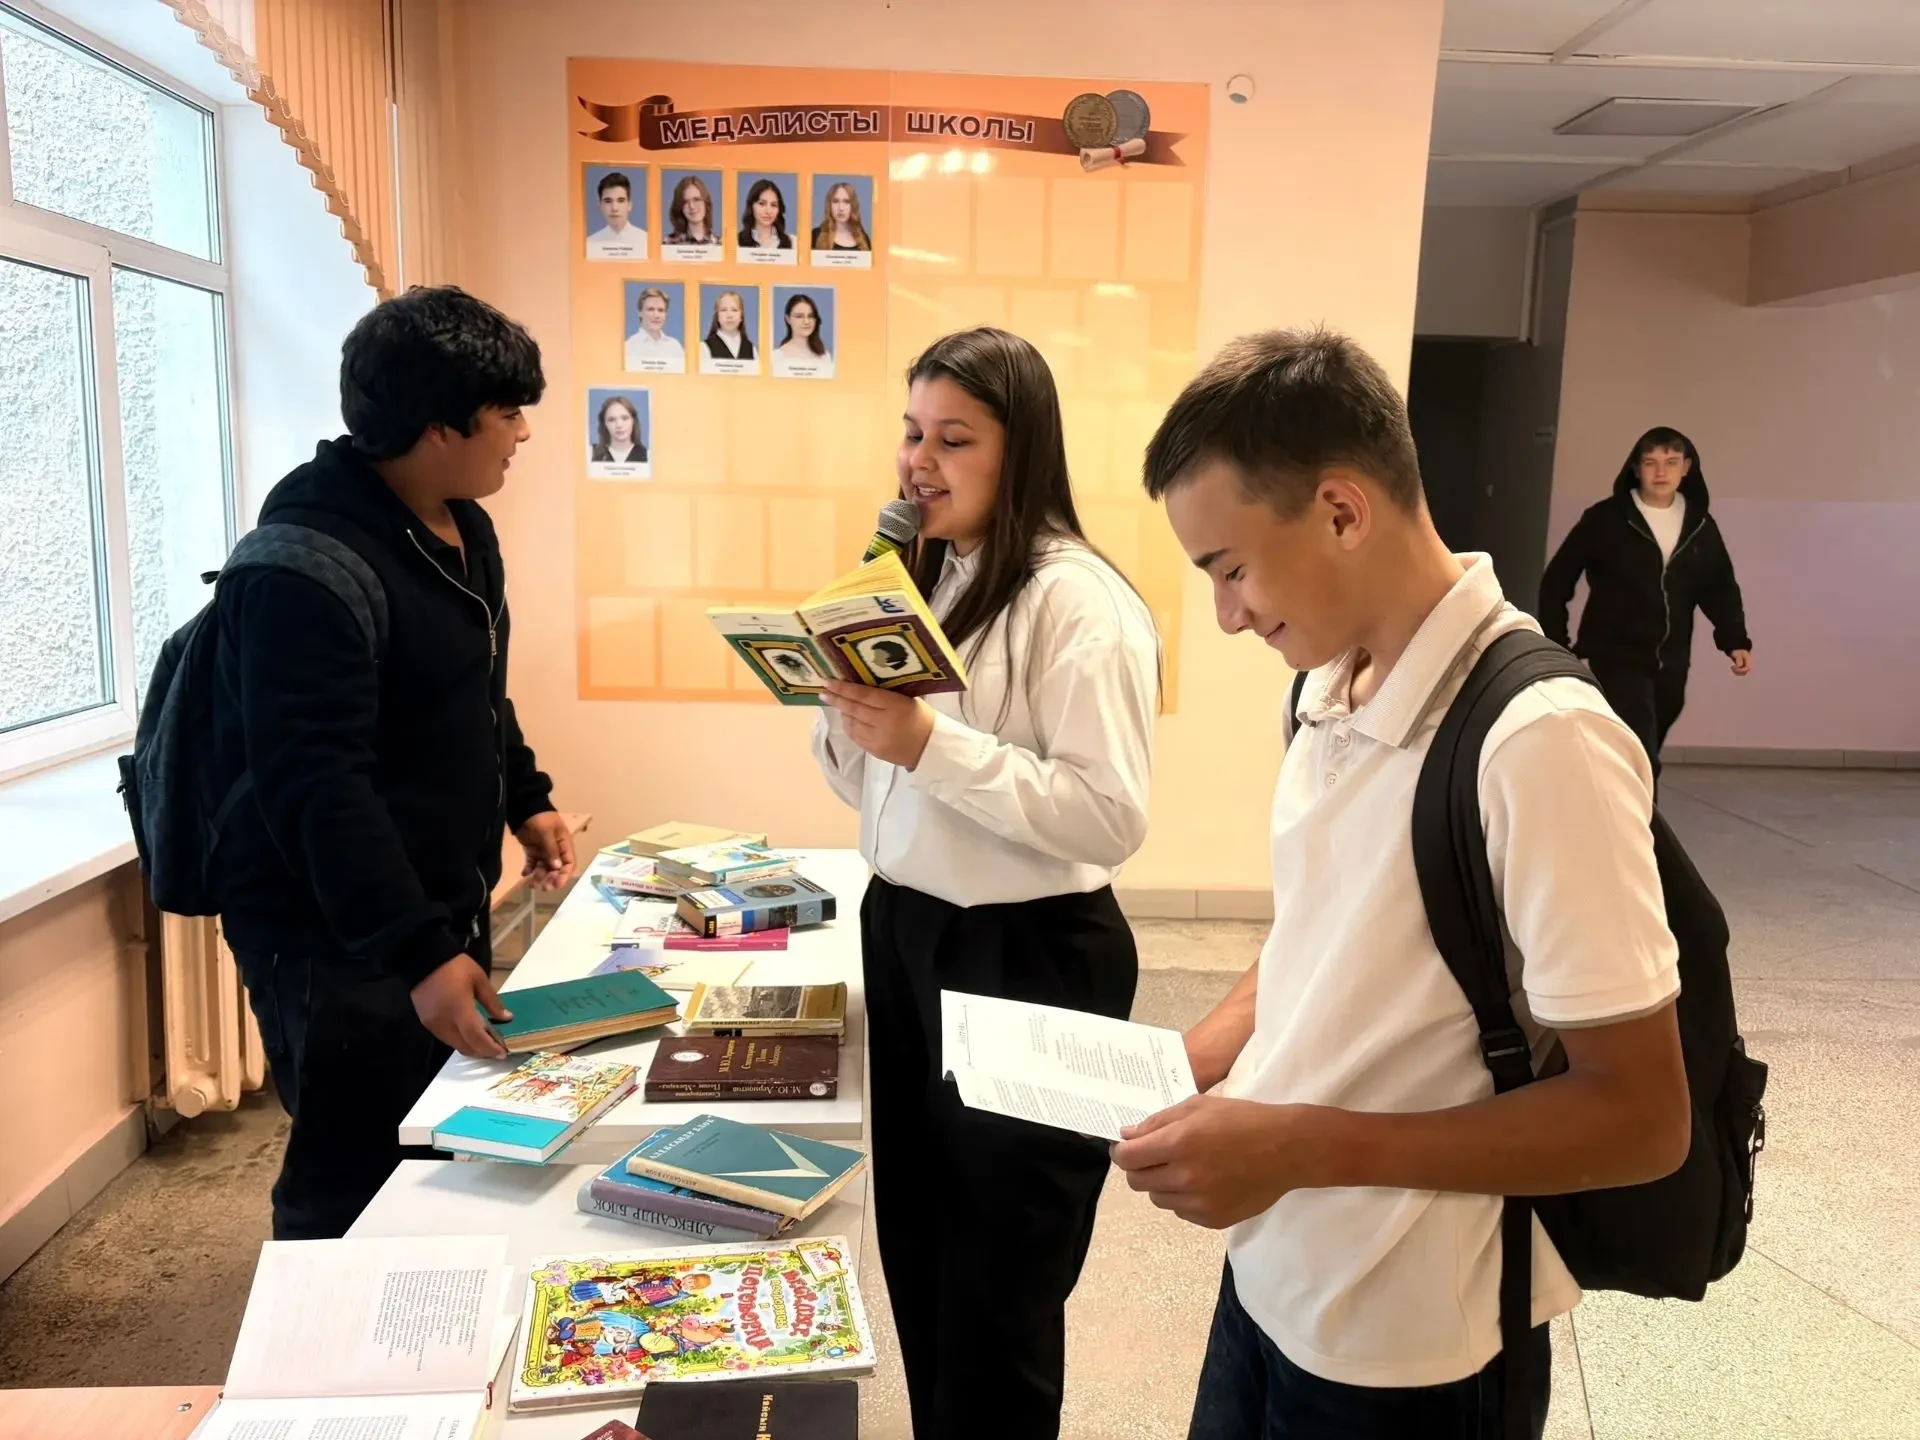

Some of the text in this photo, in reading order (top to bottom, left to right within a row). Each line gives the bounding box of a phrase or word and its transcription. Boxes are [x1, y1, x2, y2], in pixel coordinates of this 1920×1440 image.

[660, 109, 1034, 144] МЕДАЛИСТЫ ШКОЛЫ
[592, 1199, 716, 1237] АЛЕКСАНДР БЛОК
[737, 1264, 775, 1351] ПОГОВОРКИ
[758, 1394, 774, 1432] Кайсын
